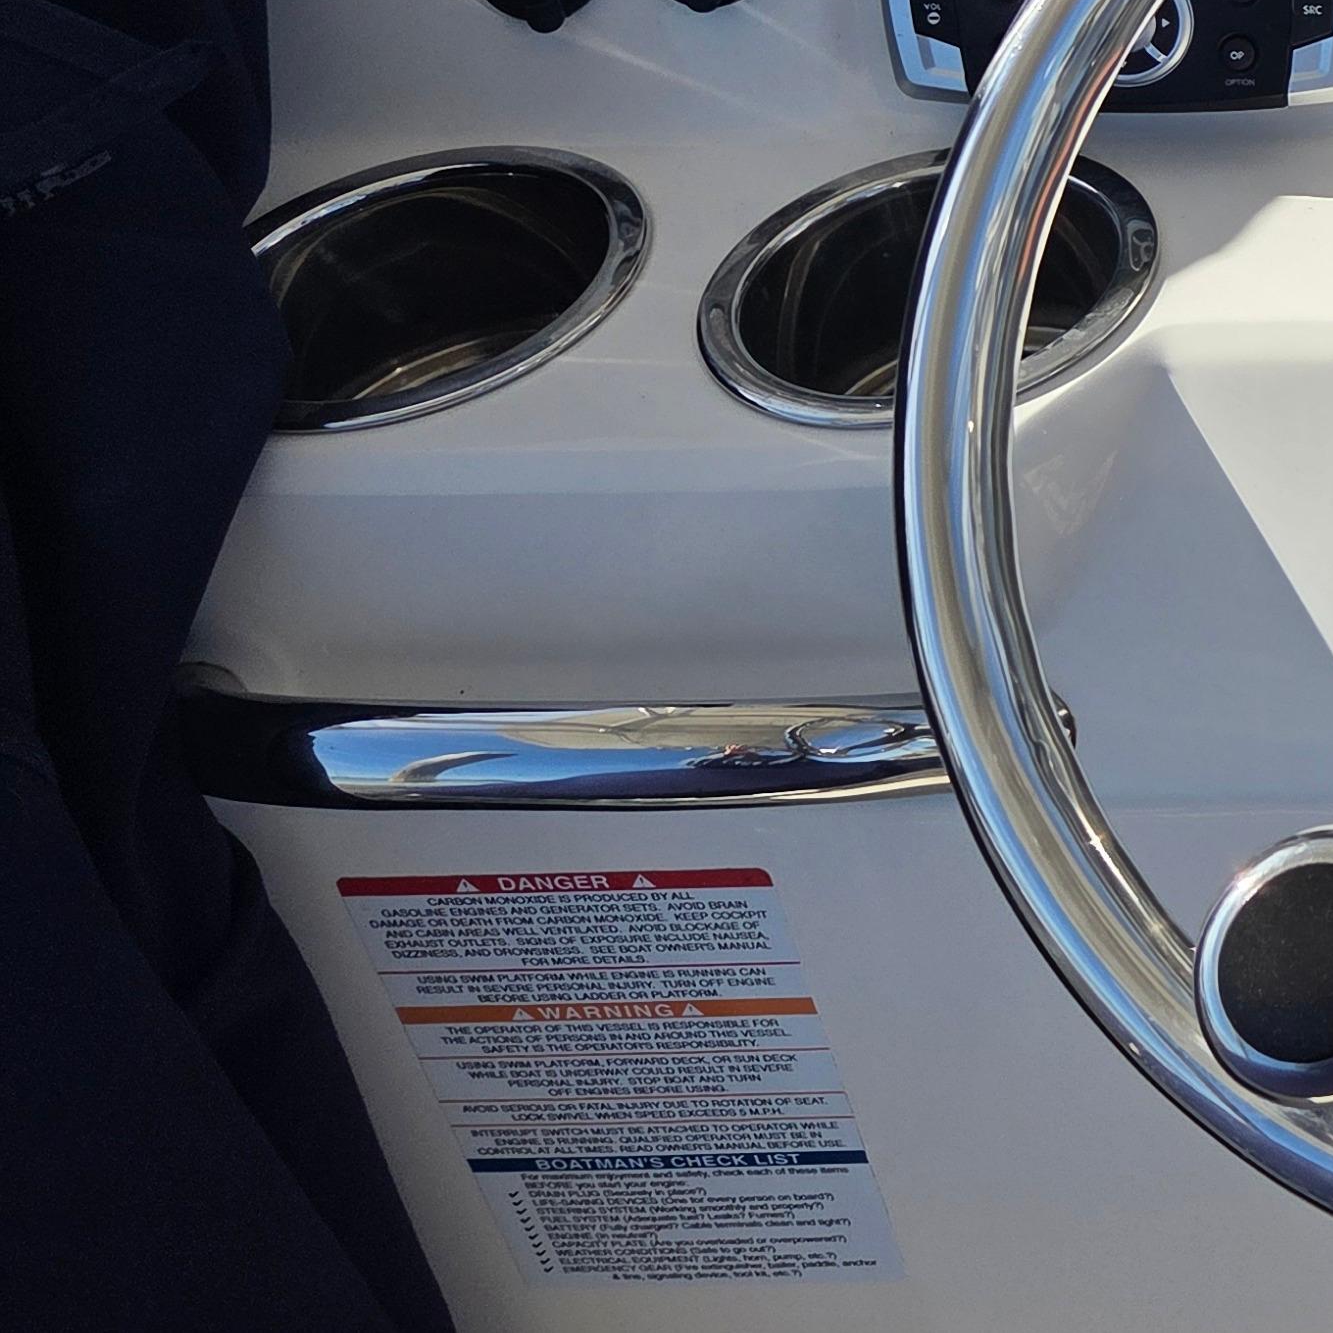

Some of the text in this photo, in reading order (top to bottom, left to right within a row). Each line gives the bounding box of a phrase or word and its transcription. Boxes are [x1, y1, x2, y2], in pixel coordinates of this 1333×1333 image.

[924, 3, 942, 11] VOL
[1302, 5, 1323, 15] SRC
[1224, 78, 1256, 87] OPTION
[498, 875, 610, 891] DANGER
[427, 891, 695, 907] CARBON MONOXIDE IS PRODUCED BY ALL
[538, 1003, 675, 1020] WARNING
[534, 1153, 801, 1170] BOATMAN'S CHECK LIST
